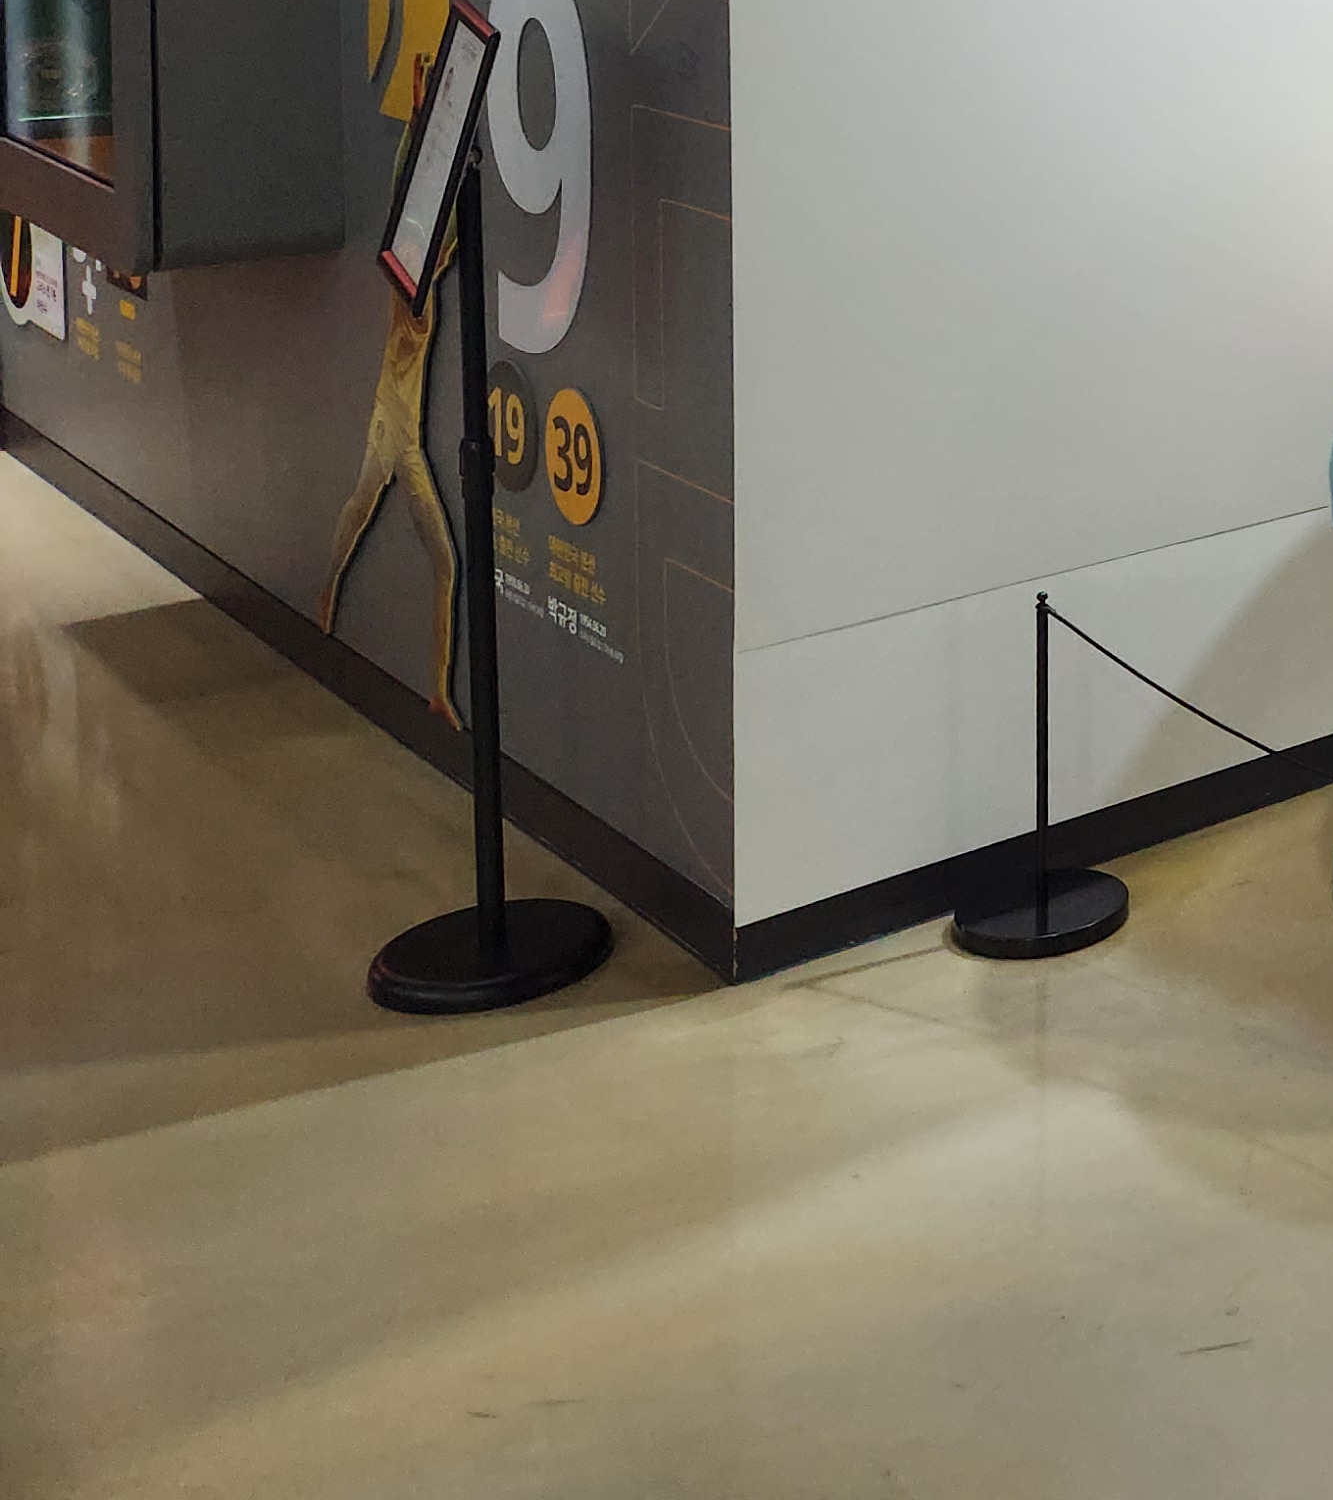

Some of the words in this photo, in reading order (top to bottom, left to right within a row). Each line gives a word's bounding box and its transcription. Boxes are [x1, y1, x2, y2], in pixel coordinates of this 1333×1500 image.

[488, 386, 524, 465] 19
[553, 415, 592, 496] 39
[548, 595, 577, 635] 박규정
